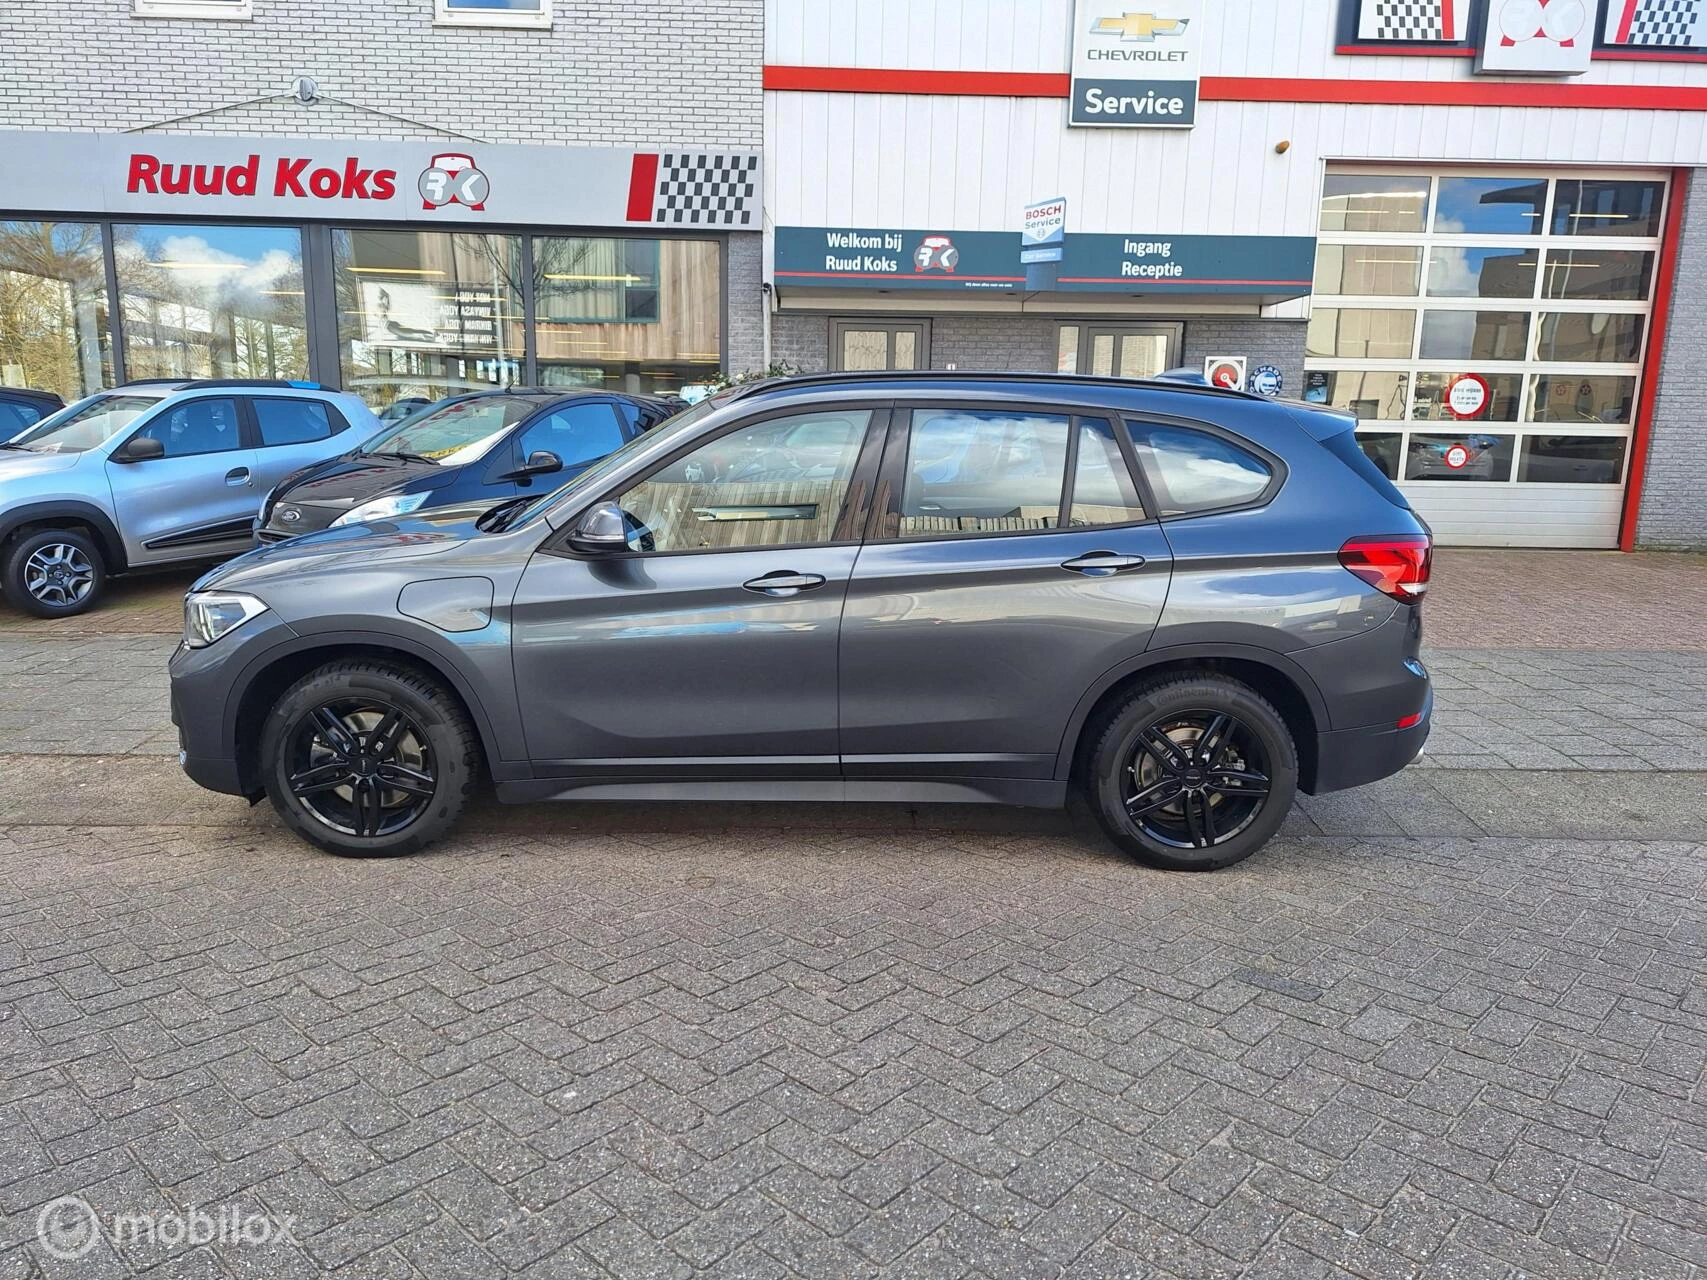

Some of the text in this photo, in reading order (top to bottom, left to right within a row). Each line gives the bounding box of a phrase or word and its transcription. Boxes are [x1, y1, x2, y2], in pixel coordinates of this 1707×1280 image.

[1087, 49, 1189, 62] CHEVROLET
[1084, 88, 1184, 115] Service
[127, 154, 396, 200] Ruud Koks
[1025, 205, 1062, 220] BOSCH
[1024, 217, 1061, 230] Service
[826, 232, 903, 252] Welkom bij
[1124, 239, 1172, 257] Ingang
[825, 255, 897, 271] Ruud Koks
[1121, 261, 1183, 279] Receptie
